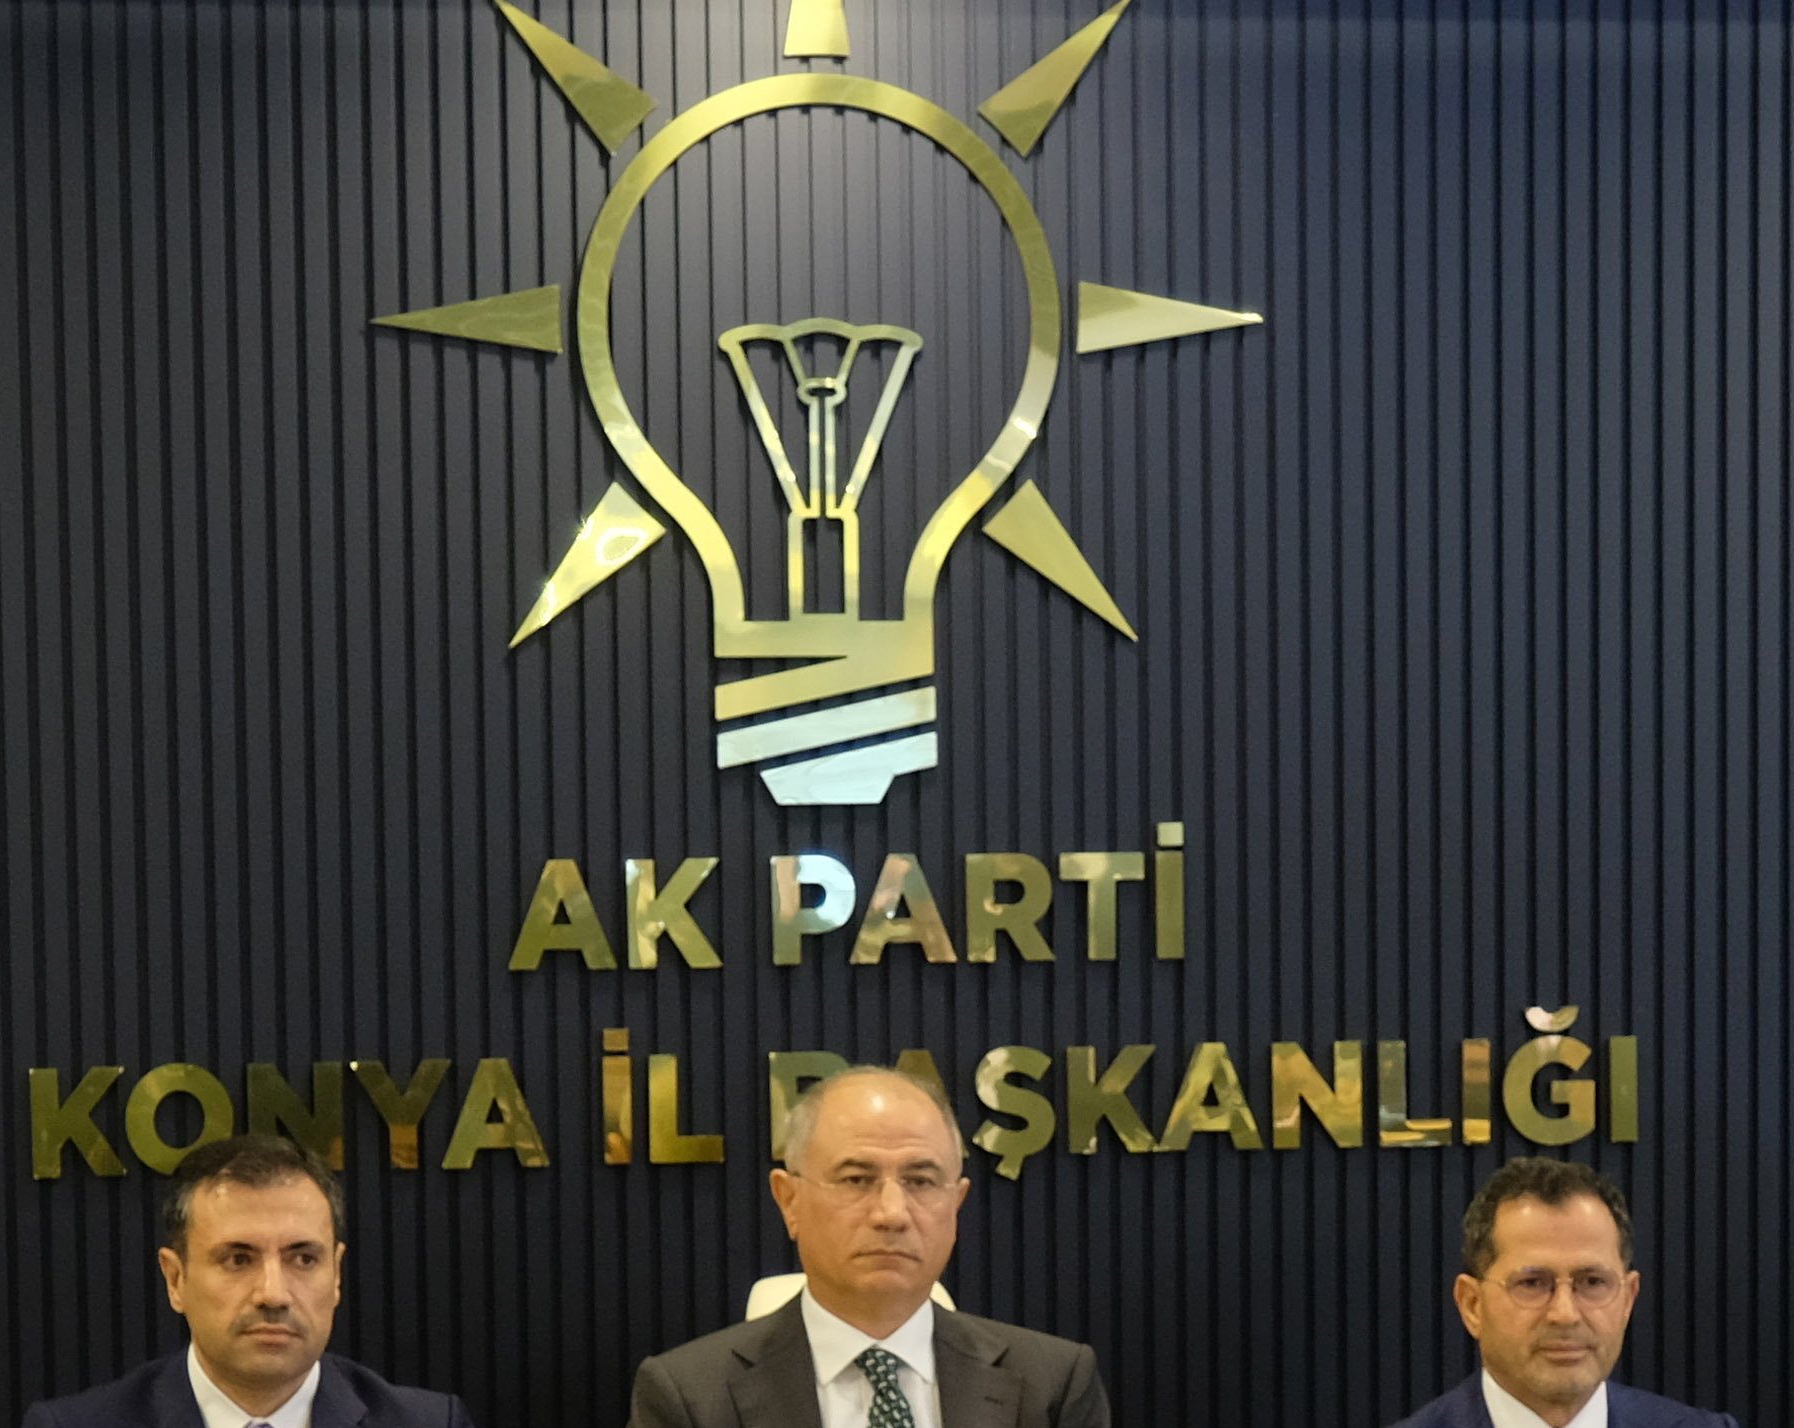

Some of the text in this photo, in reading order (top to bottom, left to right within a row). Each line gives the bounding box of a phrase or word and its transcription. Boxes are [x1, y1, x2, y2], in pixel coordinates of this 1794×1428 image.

[508, 821, 1185, 970] AK PARTİ
[28, 1005, 1639, 1182] KONYA İL ŞKANLIĞI
